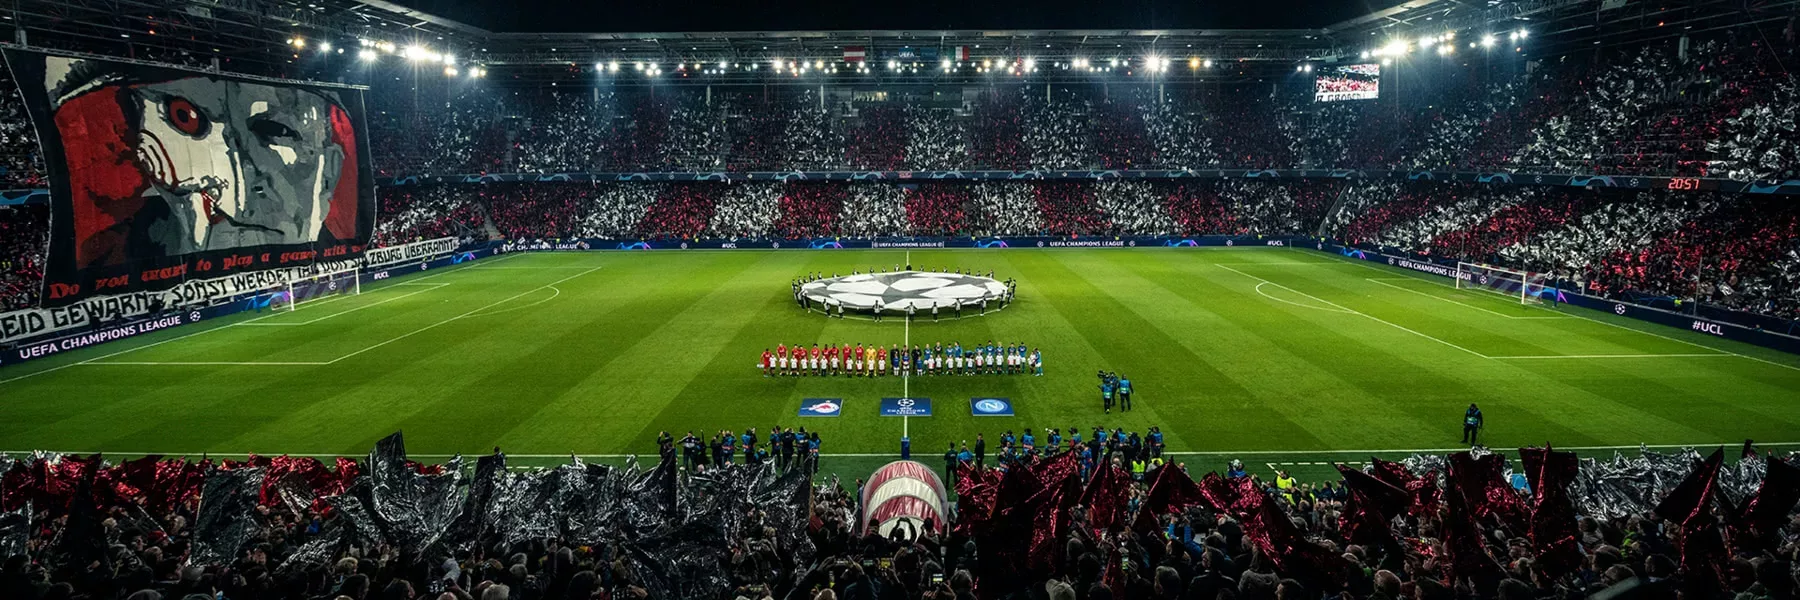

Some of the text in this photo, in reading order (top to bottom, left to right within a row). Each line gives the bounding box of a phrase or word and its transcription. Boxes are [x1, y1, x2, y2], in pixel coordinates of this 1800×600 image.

[50, 283, 80, 299] Do
[196, 258, 212, 271] to
[223, 253, 254, 270] play
[374, 271, 390, 280] #UCL
[1398, 260, 1413, 269] UEFA
[1413, 262, 1448, 276] CHAMPIONS
[228, 268, 293, 292] WERDET
[19, 315, 182, 359] UEFA CHAMPIONS LEAGUE
[1692, 320, 1724, 336] #UCL
